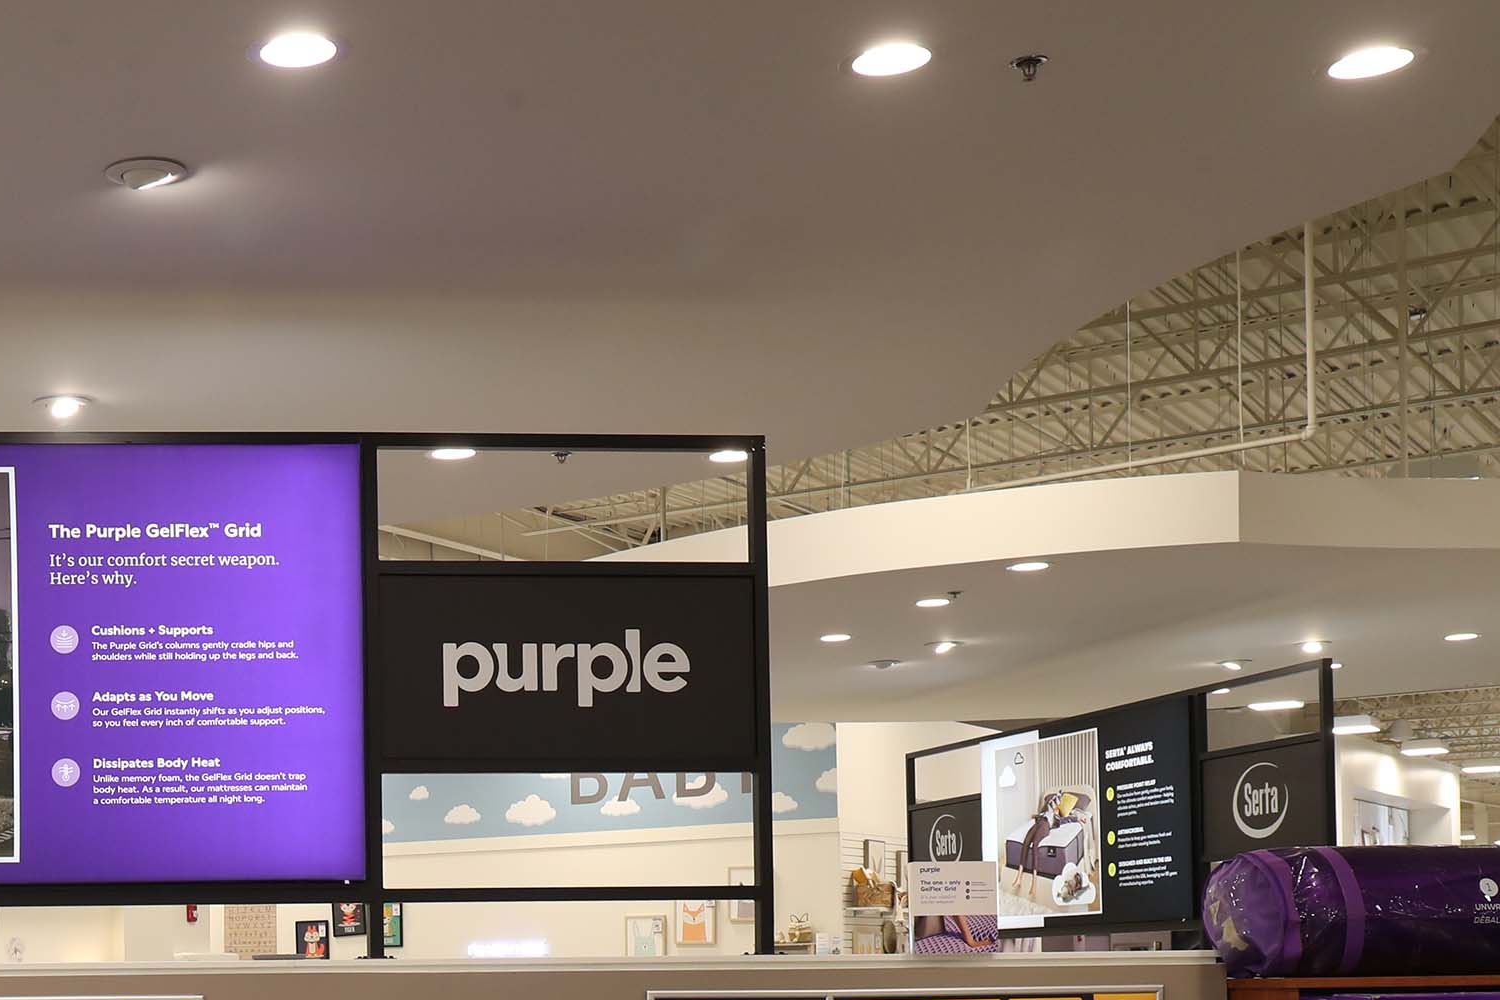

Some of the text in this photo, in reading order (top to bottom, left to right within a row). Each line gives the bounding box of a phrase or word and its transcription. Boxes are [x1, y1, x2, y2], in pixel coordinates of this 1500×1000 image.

[49, 524, 81, 538] The
[86, 524, 141, 541] Purple
[224, 523, 261, 537] Grid
[50, 553, 279, 568] It's our comfort secret weapon.
[50, 571, 137, 587] Here's why.
[91, 625, 146, 635] Cushions
[158, 625, 213, 637] Supports
[110, 642, 137, 650] Purple
[138, 641, 163, 649] Grid's
[202, 641, 229, 650] gently
[258, 640, 276, 649] hips
[277, 640, 294, 648] and
[158, 652, 173, 660] still
[175, 652, 207, 661] holding
[209, 653, 221, 661] up
[239, 652, 256, 661] legs
[258, 651, 274, 659] and
[276, 651, 299, 659] back.
[442, 628, 691, 708] purple
[92, 692, 136, 703] Adapts
[155, 691, 178, 701] You
[181, 691, 214, 701] Move
[92, 708, 109, 716] Our
[111, 708, 142, 716] GelFlex
[164, 708, 201, 716] instantly
[202, 707, 226, 715] shifts
[239, 708, 255, 716] you
[257, 706, 283, 715] adjust
[285, 706, 325, 715] positions,
[141, 720, 164, 728] every
[166, 718, 183, 726] inch
[185, 718, 195, 726] of
[197, 718, 248, 726] comfortable
[250, 718, 286, 726] support.
[1127, 741, 1153, 755] ALWAYS
[93, 757, 221, 770] Dissipates Body Heat
[158, 774, 183, 782] foam,
[201, 773, 232, 781] GelFlex
[234, 773, 253, 781] Grid
[254, 772, 286, 780] doesn't
[288, 773, 306, 781] trap
[93, 786, 116, 795] body
[142, 785, 153, 793] As
[162, 785, 188, 793] result,
[271, 783, 308, 791] maintain
[100, 796, 152, 804] comfortable
[208, 795, 218, 803] all
[219, 795, 242, 804] night
[244, 795, 265, 804] long.
[1244, 782, 1278, 817] Serta
[935, 829, 957, 857] Serta
